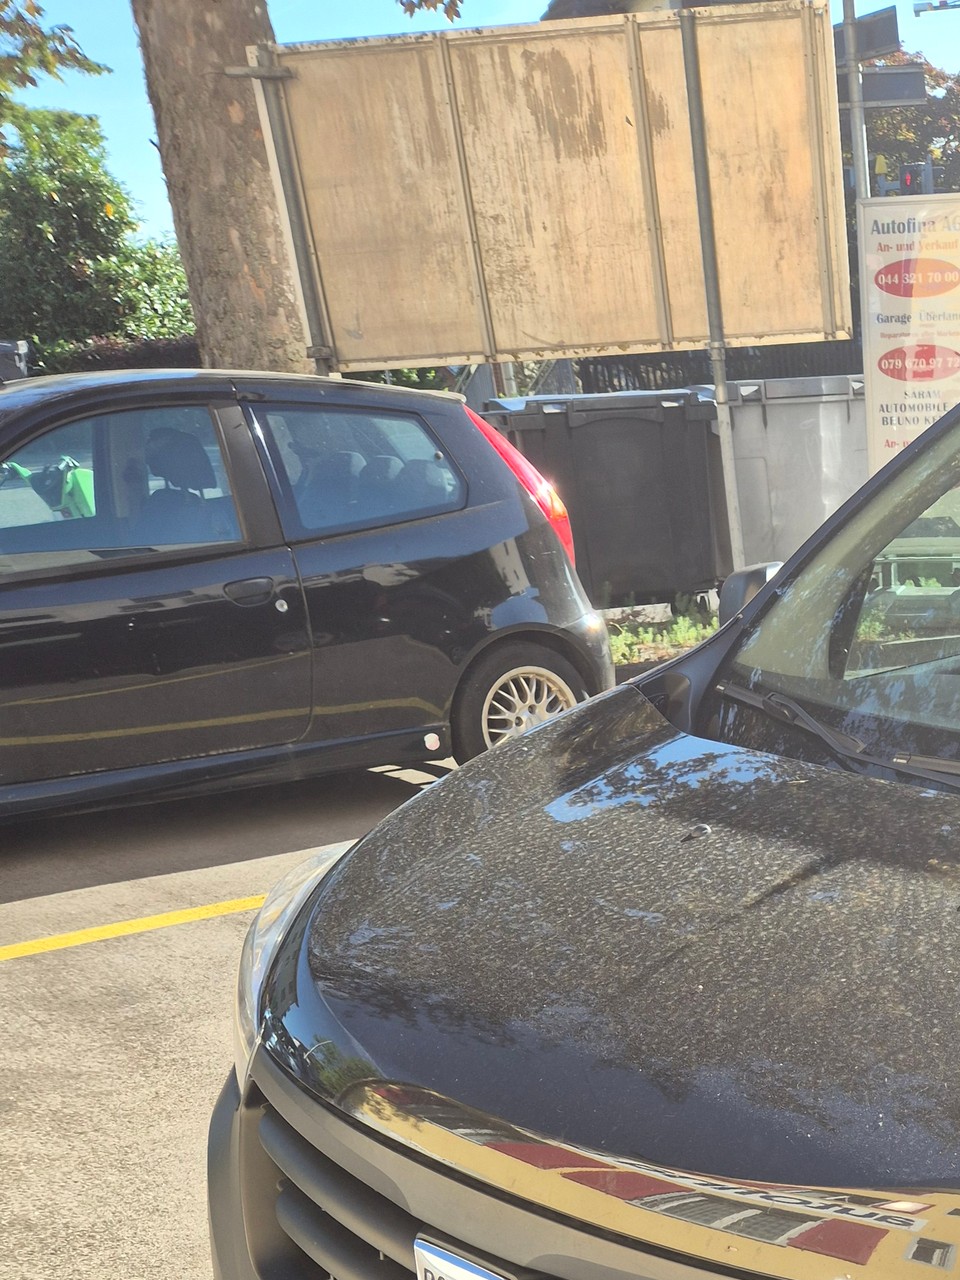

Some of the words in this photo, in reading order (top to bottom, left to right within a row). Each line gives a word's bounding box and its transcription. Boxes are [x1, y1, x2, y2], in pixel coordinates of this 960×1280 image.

[871, 217, 936, 235] Autofina
[878, 273, 899, 285] 044
[927, 272, 942, 283] 70
[944, 271, 959, 282] 00
[876, 313, 912, 325] Garage
[881, 359, 902, 370] 079
